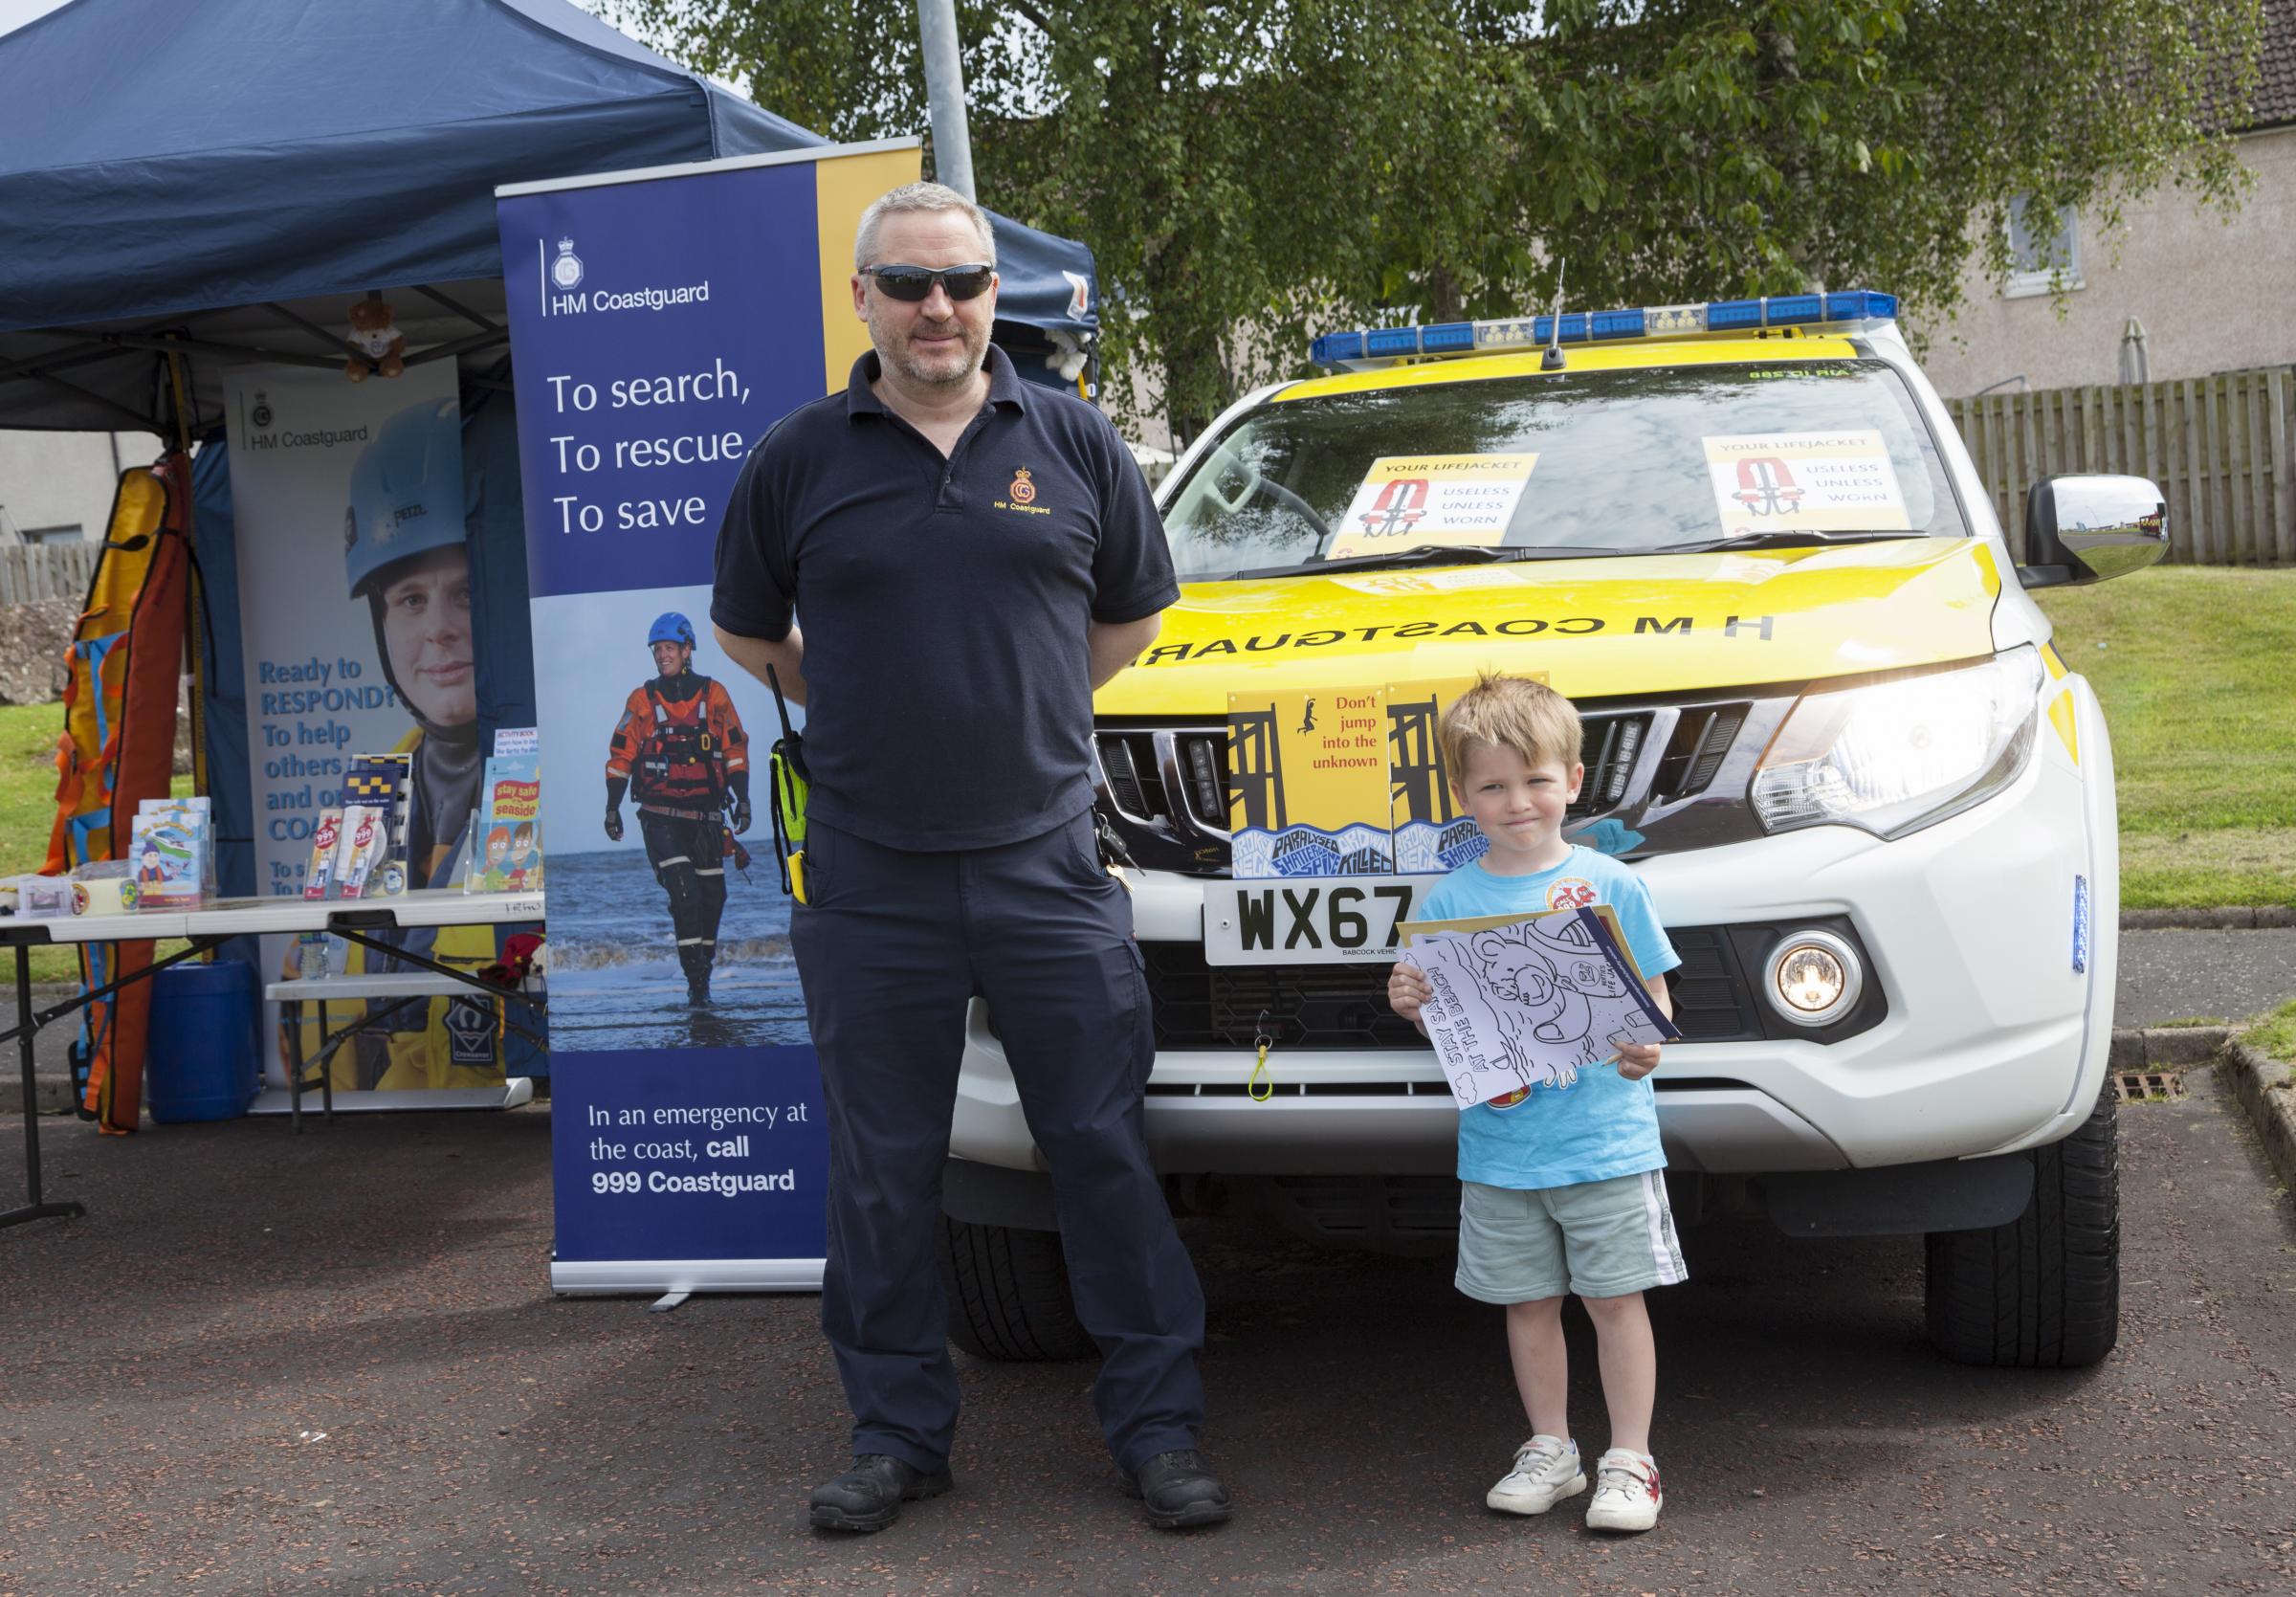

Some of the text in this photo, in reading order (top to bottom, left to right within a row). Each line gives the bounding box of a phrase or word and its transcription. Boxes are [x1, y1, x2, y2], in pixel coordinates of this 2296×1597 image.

[553, 280, 709, 316] HM Coastguard
[546, 358, 750, 413] To search,
[252, 425, 368, 451] HM Coastguard
[1720, 438, 1867, 452] YOUR LIFEJACKET
[550, 435, 601, 474] To
[1385, 461, 1522, 473] YOUR LIFEJACKET
[1806, 463, 1879, 474] USELESS
[1443, 486, 1511, 497] USELESS
[1816, 478, 1884, 488] UNLESS
[994, 500, 1050, 515] HM Coastguard
[1442, 501, 1504, 510] UNLESS
[1828, 493, 1888, 501] WORN
[553, 496, 706, 534] To save
[1444, 516, 1498, 524] WORN
[258, 656, 363, 688] Ready to
[261, 684, 396, 716] RESPOND?
[1336, 696, 1377, 710] Don't
[261, 720, 352, 751] To help
[1340, 716, 1377, 733] jump
[1323, 734, 1378, 749] into the
[264, 752, 342, 779] others
[1313, 755, 1378, 769] unknown
[266, 784, 312, 810] and
[497, 785, 538, 797] stay safe
[496, 804, 537, 817] seaside
[317, 830, 334, 843] 999
[1272, 829, 1339, 859] PARALYSED
[1438, 821, 1485, 854] PARAL
[270, 861, 292, 877] To
[1292, 852, 1340, 876] SPINE
[1338, 846, 1392, 875] KILLED
[1237, 885, 1413, 951] WX67
[1607, 980, 1617, 998] LIFE
[1426, 966, 1490, 1073] AT THE BEACH
[1426, 996, 1464, 1067] STAY SA
[588, 1102, 808, 1131] In an emergency at
[589, 1135, 750, 1163] the coast, call
[592, 1168, 795, 1198] 999 Coastguard
